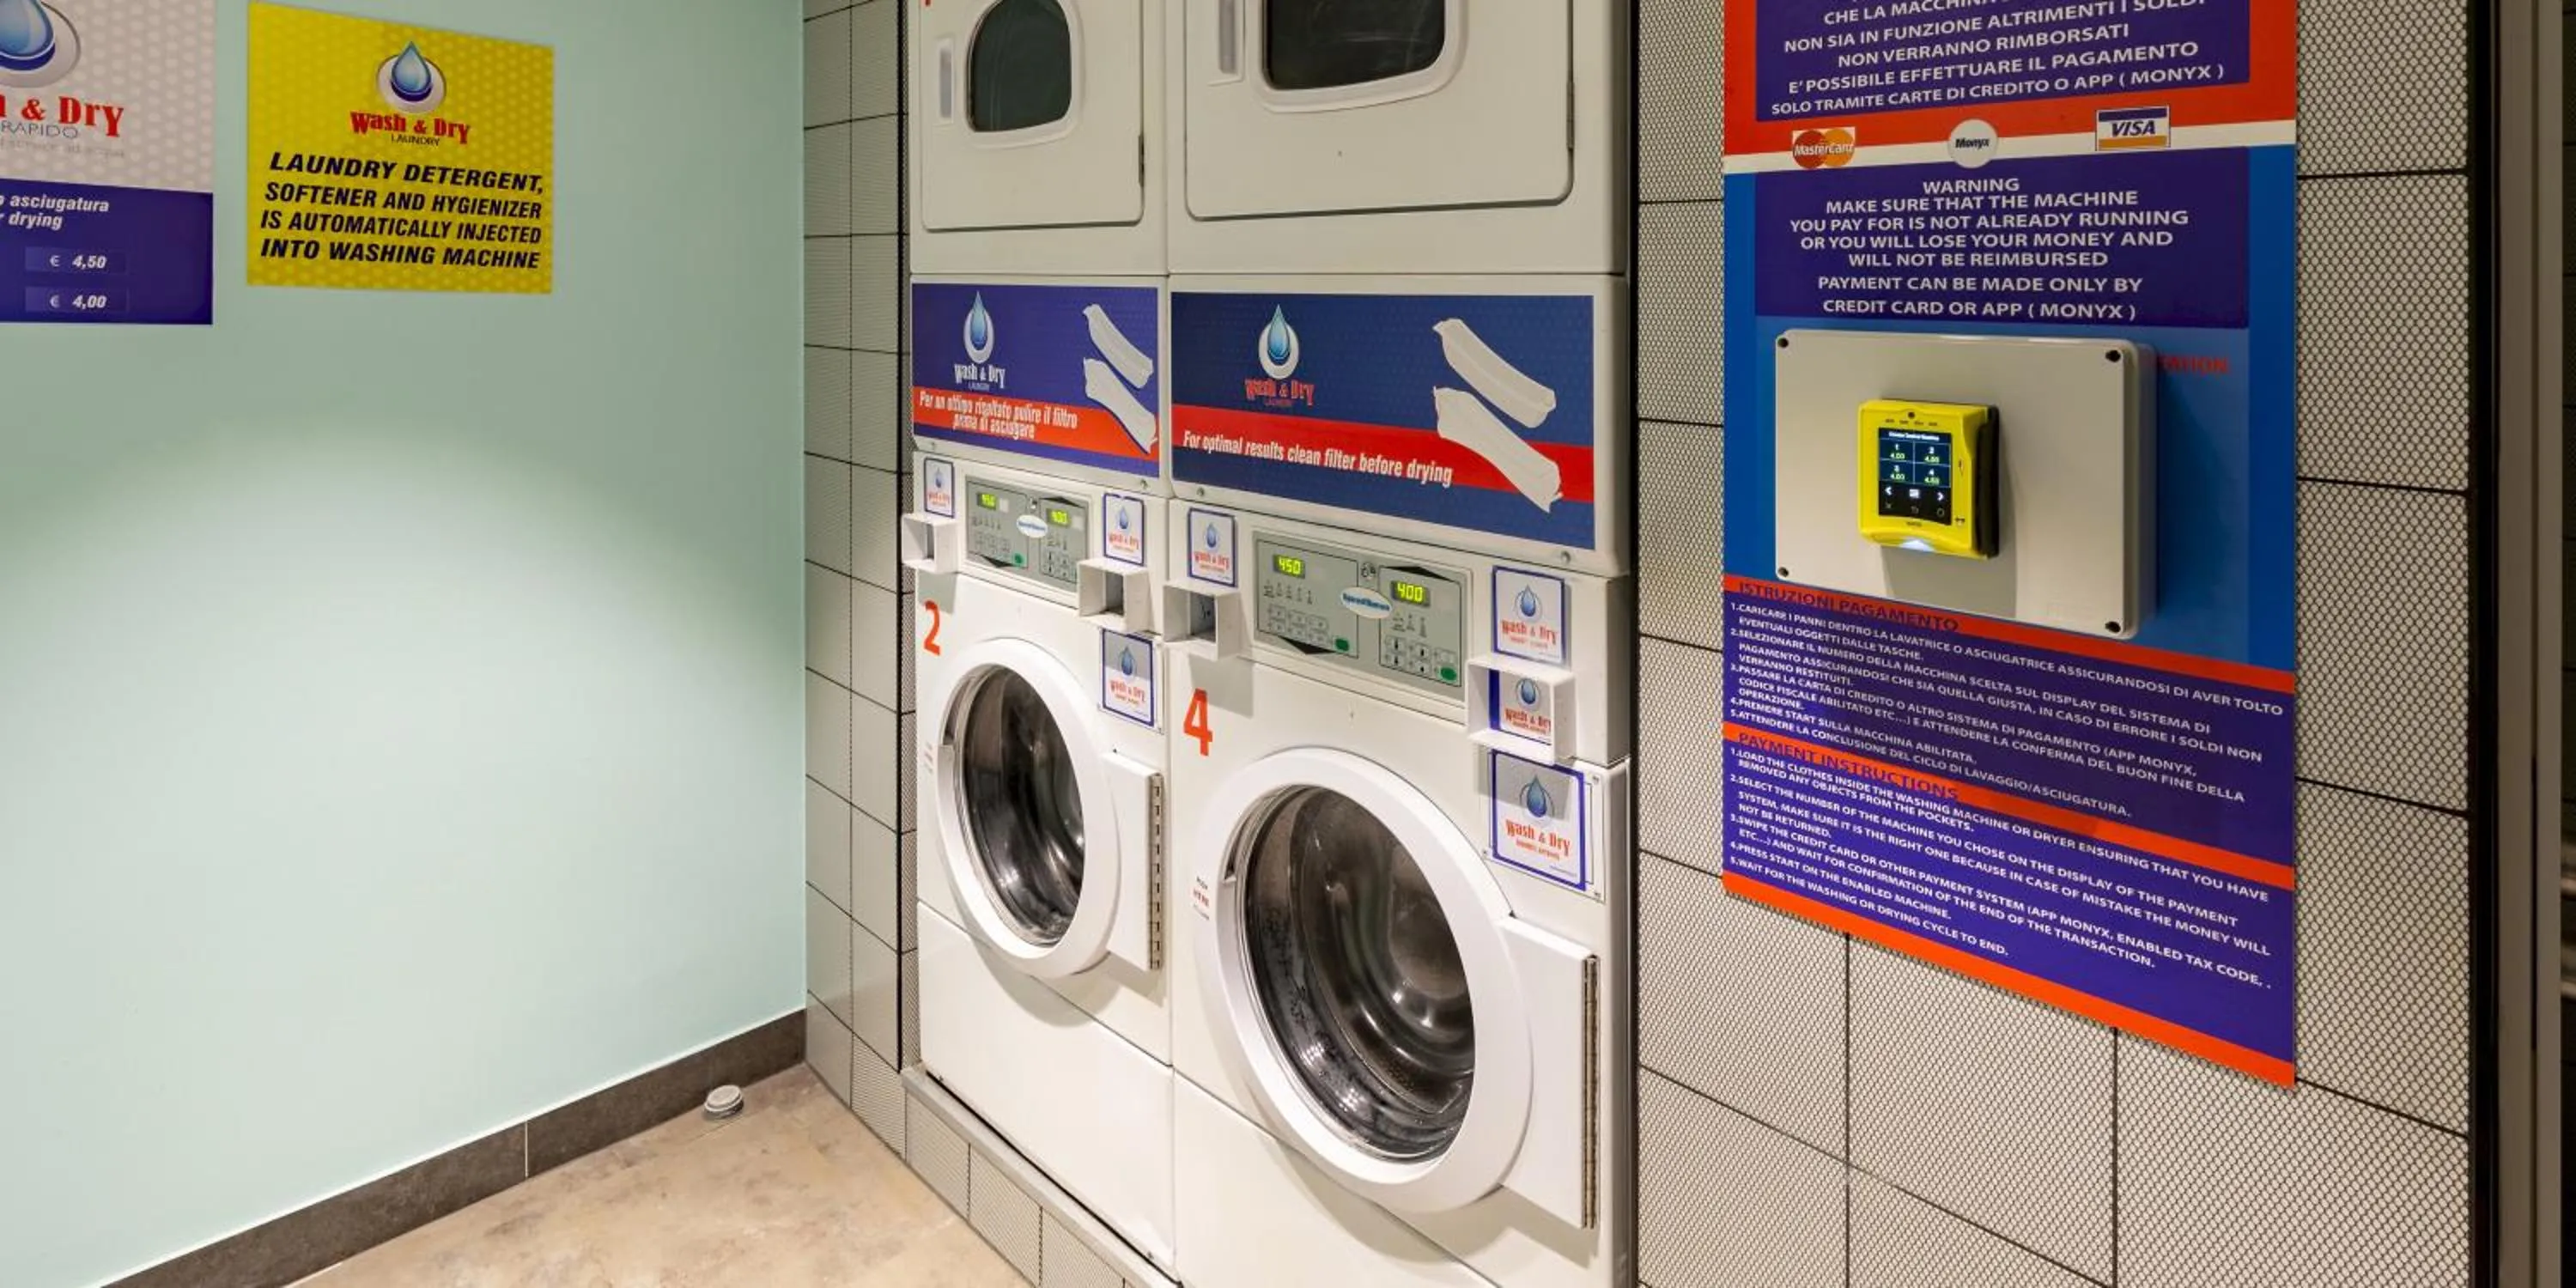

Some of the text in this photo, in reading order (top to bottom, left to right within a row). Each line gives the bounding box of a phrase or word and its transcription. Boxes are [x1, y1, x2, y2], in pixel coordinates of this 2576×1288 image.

[1825, 0, 1996, 25] CHE LA MACCHI
[1785, 33, 1822, 52] NON
[1827, 33, 1855, 47] SIA
[1862, 31, 1878, 44] IN
[1885, 18, 1982, 40] FUNZIONE
[1988, 1, 2114, 27] ALTRIMENTI
[1838, 23, 2129, 68] NON VERRANNO RIMBORSATI
[1901, 61, 2023, 83] EFFETTUARE
[2028, 58, 2044, 70] IL
[2052, 41, 2198, 69] PAGAMENTO
[1772, 65, 2210, 115] SOLO TRAMITE CARTE DI CREDITO O APP MONYX
[1, 120, 79, 139] RAPIDO
[21, 97, 46, 120] &
[58, 96, 124, 137] Dry
[350, 112, 470, 144] Wash & Dry
[2111, 120, 2156, 137] VISA
[391, 134, 440, 146] LAUNDRY
[270, 152, 543, 194] LAUNDRY DETERGENT,
[1923, 179, 2020, 194] WARNING
[9, 194, 109, 212] asciugatura
[265, 182, 542, 219] SOFTENER AND HYGIENIZER
[1826, 191, 2138, 214] MAKE SURE THAT THE MACHINE
[9, 212, 62, 230] drying
[260, 210, 542, 244] IS AUTOMATICALLY INJECTED
[1791, 210, 2189, 232] YOU PAY FOR IS NOT ALREADY RUNNING
[1801, 231, 2172, 250] OR YOU WILL LOSE YOUR MONEY AND
[50, 255, 107, 269] € 4,50
[260, 239, 539, 269] INTO WASHING MACHINE
[1849, 252, 2109, 266] WILL NOT BE REIMBURSED
[1819, 276, 2142, 292] PAYMENT CAN BE MADE ONLY BY
[50, 295, 107, 309] € 4,00
[1823, 300, 2123, 319] CREDIT CARD OR APP MONYX
[954, 363, 977, 384] Wash
[989, 363, 1005, 388] Dry
[1291, 380, 1315, 406] Dry
[920, 392, 934, 406] Per
[1053, 406, 1078, 428] filtro
[991, 417, 1035, 440] asciugare
[1183, 430, 1453, 488] For optimal results clean filter before drying
[1277, 556, 1302, 574] 450
[1397, 582, 1424, 601] 400
[1740, 582, 1959, 633] ISTRUZIONI PAGAMENTO
[923, 600, 941, 656] 2
[1794, 614, 1826, 628] PANNI
[1828, 620, 1870, 636] DENTRO
[1873, 629, 1887, 640] LA
[1891, 632, 1951, 652] LAVATRICE
[1953, 644, 1962, 654] O
[1964, 646, 2054, 672] ASCIUGATRICE
[2057, 664, 2170, 695] ASSICURANDOSI
[2173, 685, 2188, 698] DI
[2192, 689, 2231, 707] AVER
[2234, 697, 2282, 716] TOLTO
[1183, 688, 1213, 756] 4
[1739, 732, 1958, 801] PAYMENT INSTRUCTIONS
[1505, 818, 1534, 837] Wash
[1549, 832, 1571, 857] Dry
[1775, 786, 1793, 799] THE
[1795, 792, 1839, 812] NUMBER
[1842, 805, 1856, 817] OF
[1859, 810, 1879, 824] THE
[1881, 817, 1934, 840] MACHINE
[1936, 832, 1961, 848] YOU
[1964, 840, 2004, 860] CHOSE
[2008, 852, 2026, 867] ON
[2030, 859, 2054, 875] THE
[2057, 866, 2112, 891] DISPLAY
[2116, 883, 2135, 898] OF
[2137, 889, 2165, 907] THE
[2168, 898, 2238, 928] PAYMENT
